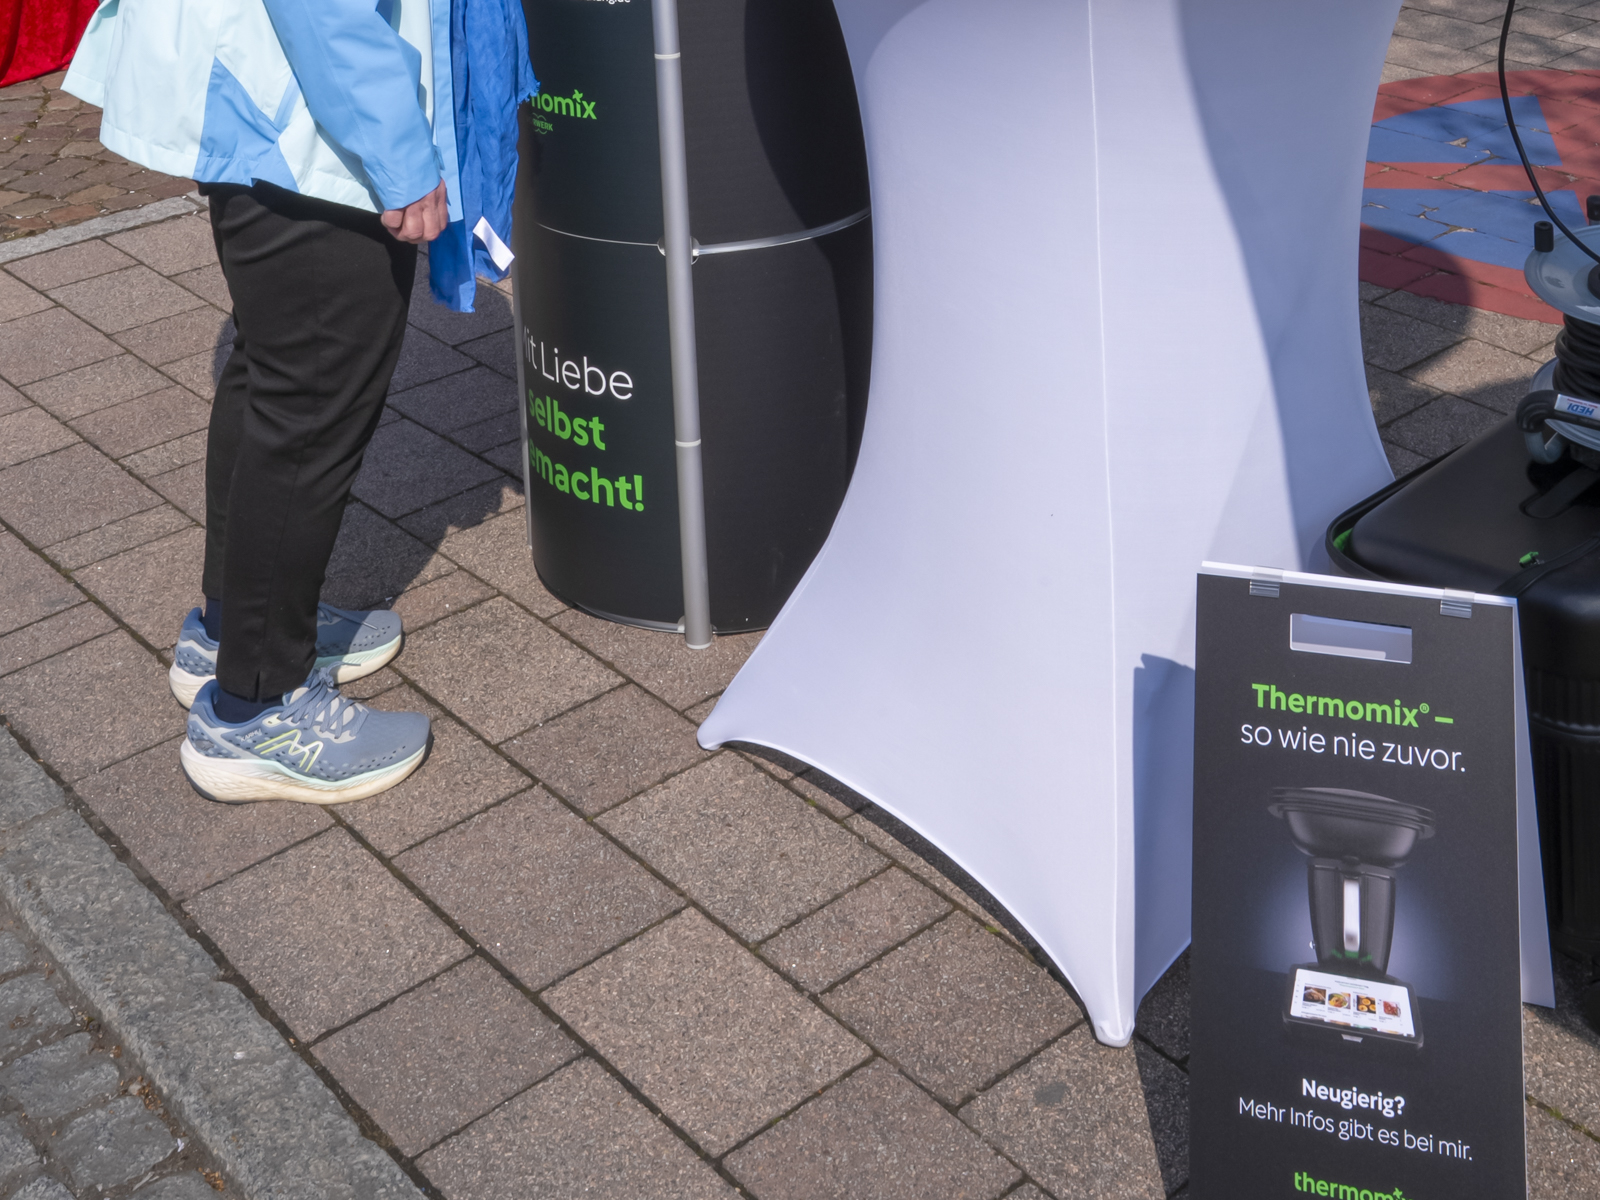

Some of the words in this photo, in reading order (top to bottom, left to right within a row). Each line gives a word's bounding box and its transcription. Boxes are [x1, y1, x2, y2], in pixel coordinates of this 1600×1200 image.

[541, 341, 633, 400] Liebe
[1240, 723, 1272, 746] so
[1278, 726, 1326, 754] wie
[1333, 732, 1376, 760] nie
[1382, 742, 1466, 773] zuvor.
[1302, 1078, 1406, 1118] Neugierig?
[1239, 1097, 1286, 1123] Mehr
[1290, 1107, 1335, 1134] Infos
[1338, 1118, 1374, 1141] gibt
[1377, 1128, 1400, 1146] es
[1404, 1129, 1433, 1153] bei
[1438, 1140, 1473, 1161] mir.
